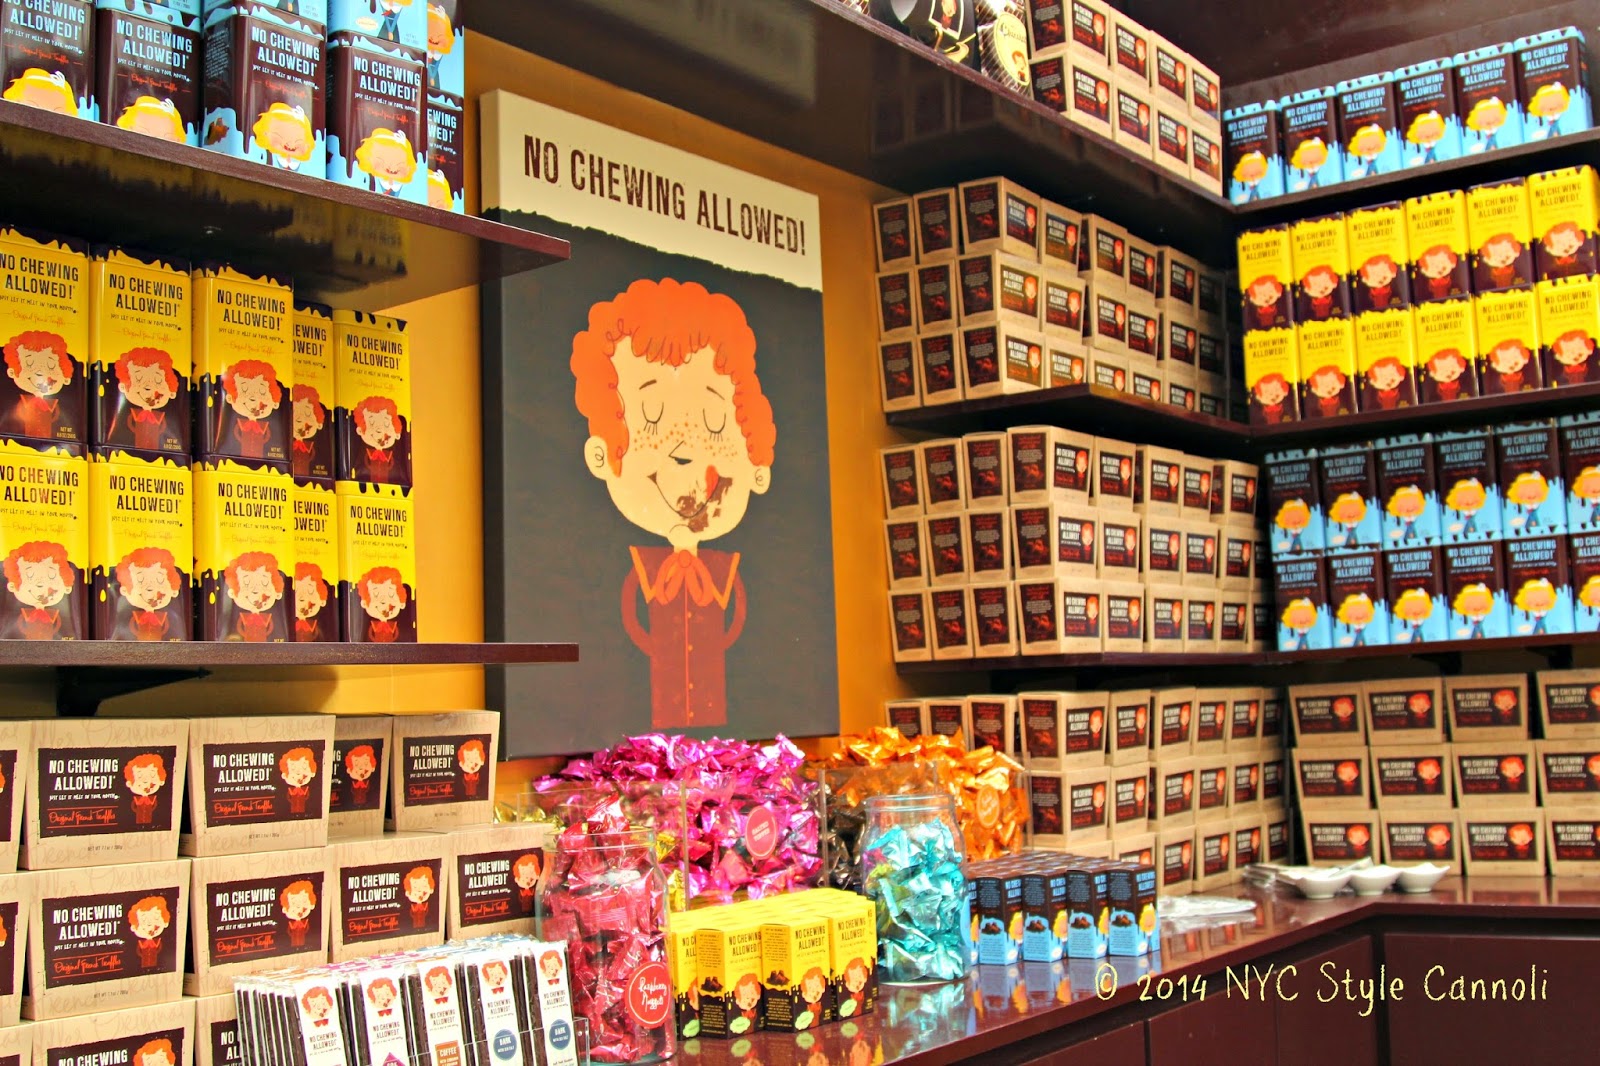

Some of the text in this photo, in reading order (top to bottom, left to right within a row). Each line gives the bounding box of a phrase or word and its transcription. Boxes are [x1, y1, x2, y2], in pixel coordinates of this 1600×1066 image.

[25, 0, 85, 24] CHEWING
[117, 19, 133, 36] NO
[137, 23, 192, 53] CHEWING
[251, 26, 320, 61] NO CHEWING
[123, 40, 186, 69] ALLOWED!
[257, 47, 315, 77] ALLOWED!
[1521, 43, 1568, 62] NO CHEWING
[354, 56, 421, 86] NO CHEWING
[360, 75, 417, 102] ALLOWED!
[524, 134, 806, 256] NO CHEWING ALLOWED!
[0, 253, 79, 282] NO CHEWING
[5, 274, 72, 299] ALLOWED!
[109, 273, 183, 300] NO CHEWING
[116, 294, 177, 317] ALLOWED!
[217, 289, 285, 314] NO CHEWING
[223, 309, 280, 331] ALLOWED!
[347, 334, 403, 355] NO CHEWING
[352, 351, 399, 370] ALLOWED!
[0, 465, 79, 487] NO CHEWING
[110, 475, 184, 496] NO CHEWING
[218, 482, 287, 502] NO CHEWING
[117, 495, 178, 514] ALLOWED!
[224, 502, 282, 519] ALLOWED!
[350, 505, 407, 522] NO CHEWING
[356, 522, 404, 538] ALLOWED!
[213, 752, 274, 768] NO CHEWING
[410, 744, 454, 757] NO CHEWING
[49, 758, 119, 774] NO CHEWING
[54, 775, 113, 791] ALLOWED!
[218, 768, 270, 784] ALLOWED!
[464, 860, 510, 875] NO CHEWING
[348, 873, 400, 889] NO CHEWING
[216, 888, 276, 907] NO CHEWING
[352, 888, 396, 904] ALLOWED!
[53, 904, 123, 925] NO CHEWING
[221, 904, 271, 922] ALLOWED!
[59, 921, 118, 940] ALLOWED!
[795, 925, 825, 939] NO CHEWING
[838, 918, 866, 931] NO CHEWING
[729, 932, 761, 946] NO CHEWING
[487, 998, 511, 1009] NO CHEWING
[543, 989, 566, 1000] NO CHEWING
[430, 1009, 456, 1019] NO CHEWING
[379, 1021, 400, 1030] CHEWING
[316, 1032, 337, 1041] CHEWING
[77, 1049, 128, 1066] CHEWING
[439, 1047, 457, 1057] COFFEE
